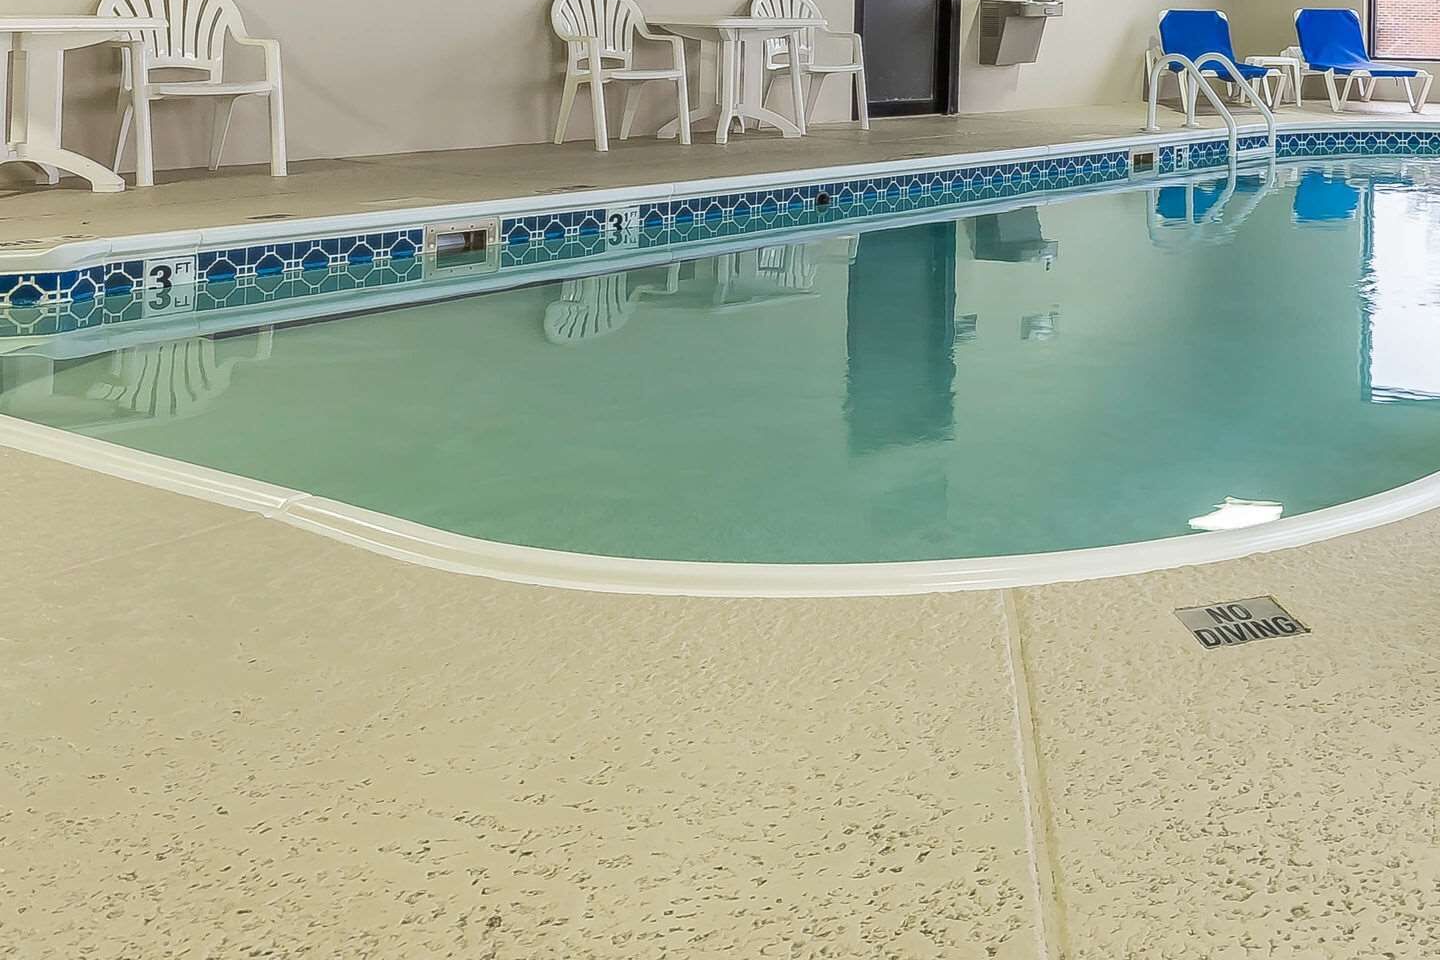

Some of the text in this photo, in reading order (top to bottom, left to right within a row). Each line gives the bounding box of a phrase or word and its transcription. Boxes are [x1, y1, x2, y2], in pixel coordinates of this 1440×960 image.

[609, 213, 623, 230] 3
[150, 262, 192, 289] 3 FT
[1204, 604, 1253, 624] NO
[1193, 616, 1298, 647] DIVING
